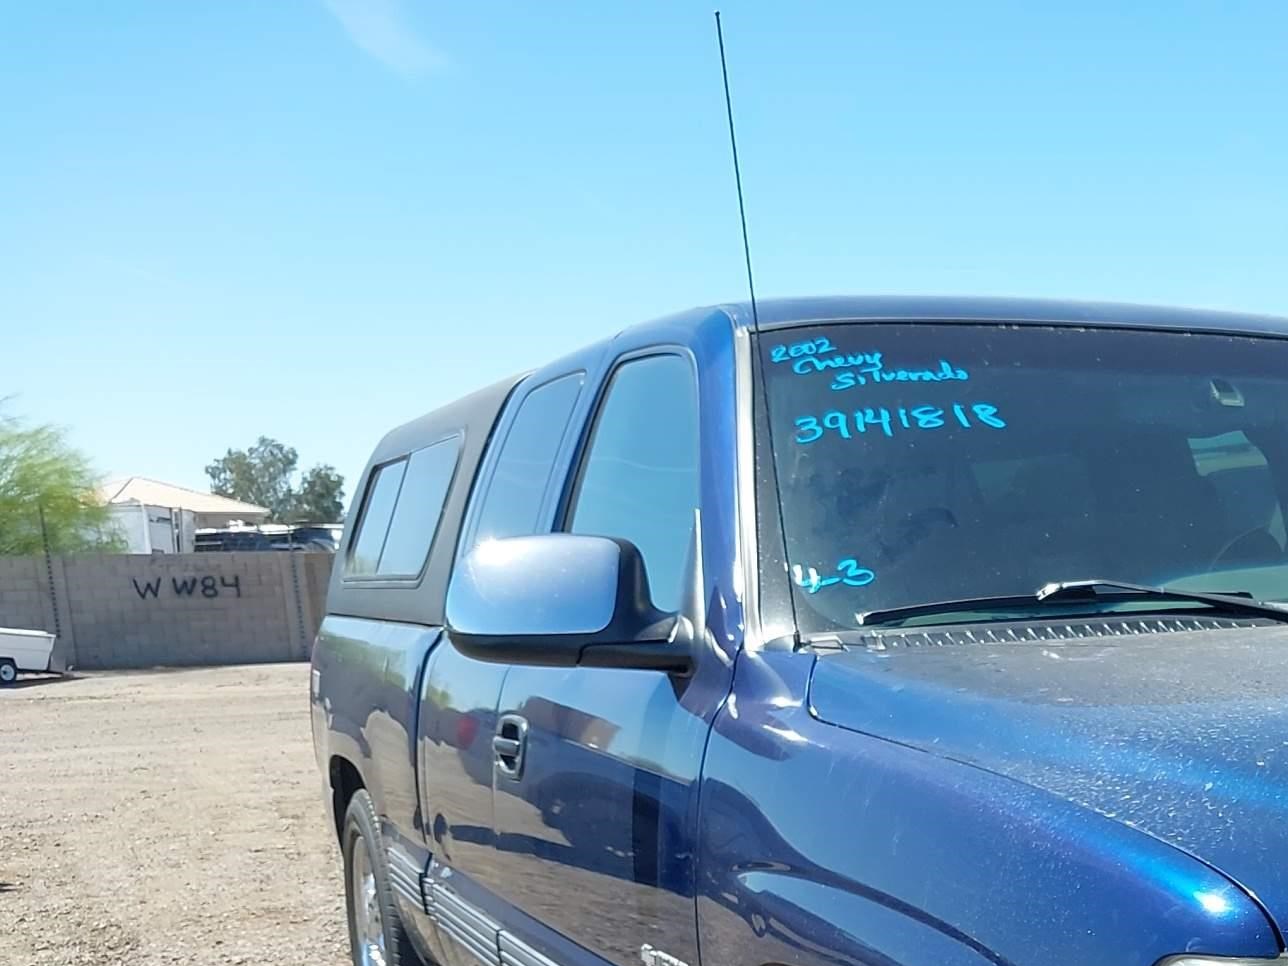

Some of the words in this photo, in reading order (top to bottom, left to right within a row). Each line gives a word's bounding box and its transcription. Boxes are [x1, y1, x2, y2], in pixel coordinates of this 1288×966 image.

[771, 337, 837, 362] 2002
[793, 352, 883, 374] Chevy
[795, 403, 1006, 443] 39141818
